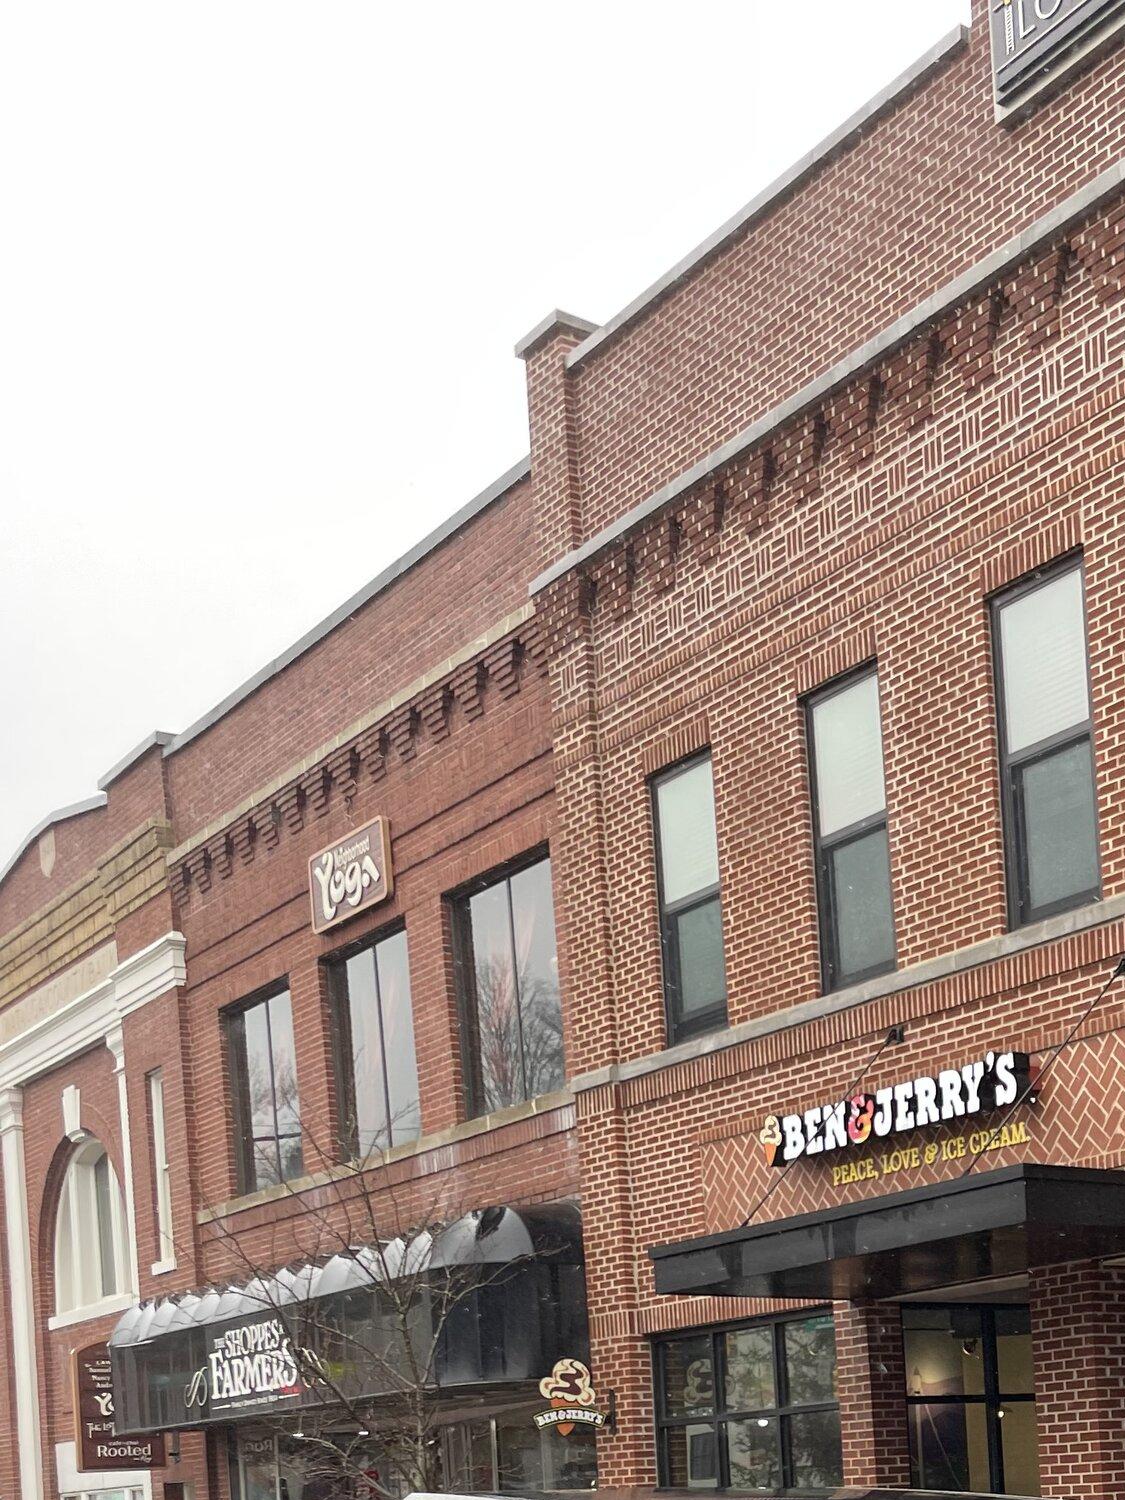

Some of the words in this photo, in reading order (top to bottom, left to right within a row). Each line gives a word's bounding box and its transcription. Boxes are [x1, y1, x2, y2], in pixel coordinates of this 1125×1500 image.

[314, 851, 380, 920] Yoga
[783, 1100, 848, 1160] BEN
[848, 1093, 874, 1144] &
[874, 1051, 1018, 1137] JERRY'S
[832, 1158, 879, 1187] PEACE,
[883, 1146, 920, 1174] LOVE
[924, 1143, 938, 1165] &
[941, 1136, 966, 1160] ICE
[225, 1319, 280, 1358] SHOPPES
[209, 1338, 298, 1400] FARMERS
[536, 1411, 558, 1426] BEN
[97, 1443, 151, 1457] Rooted
